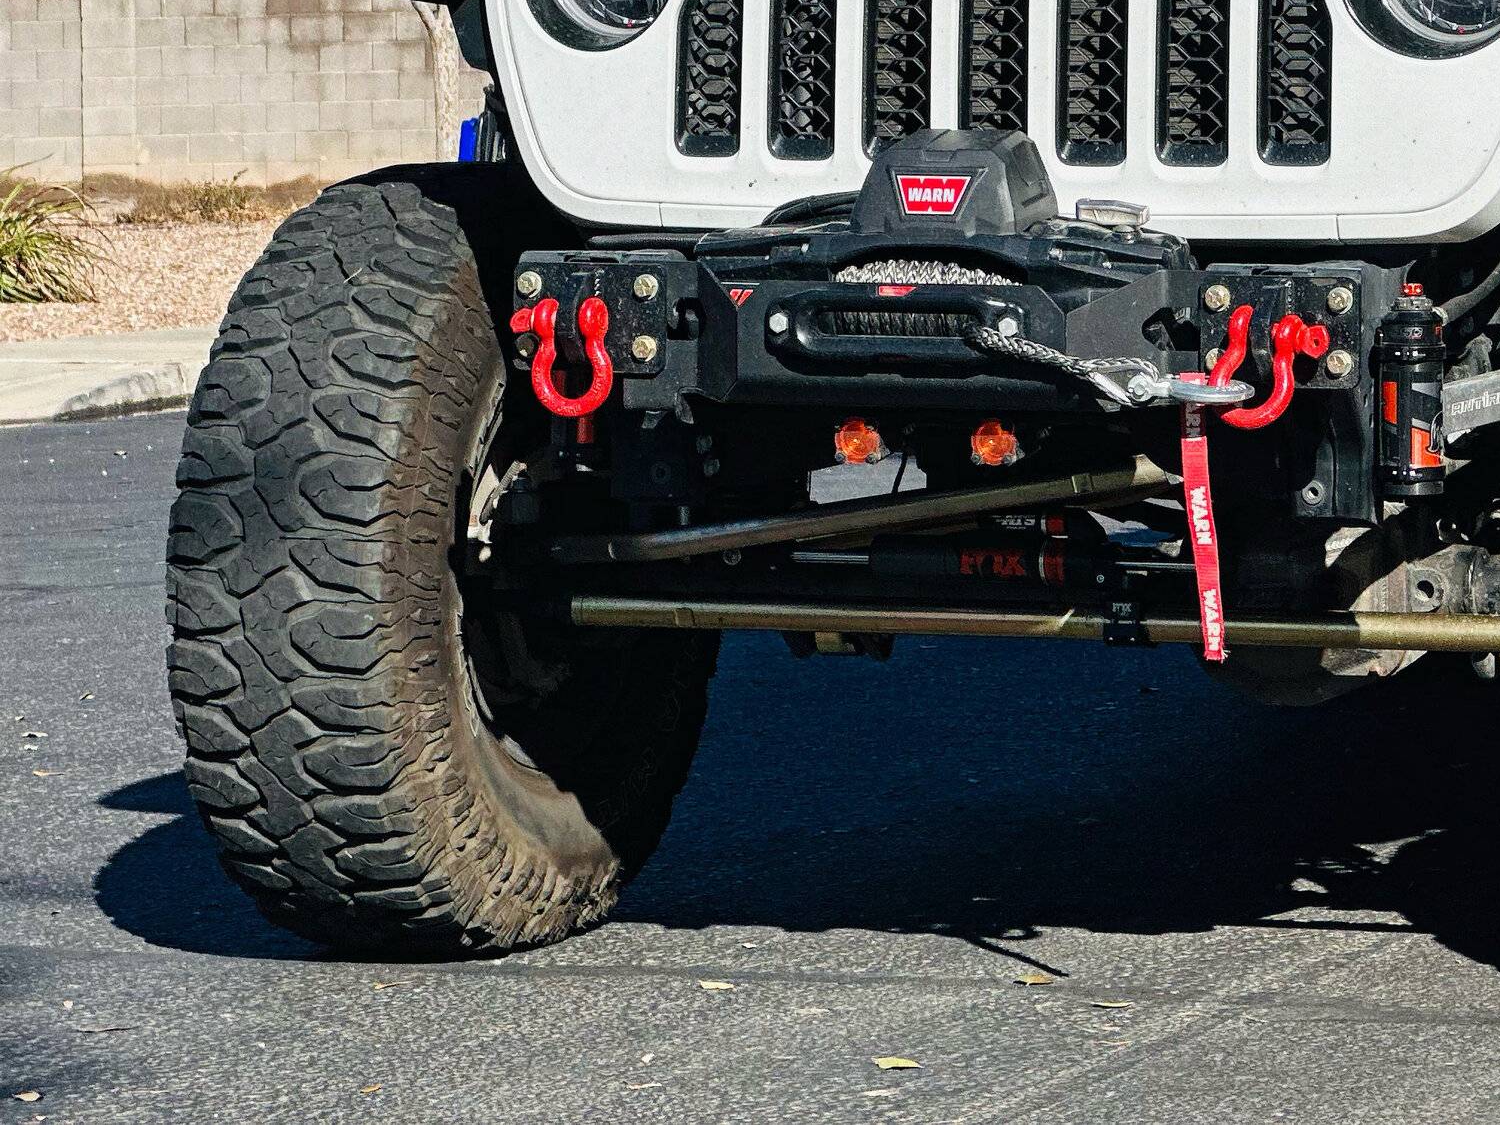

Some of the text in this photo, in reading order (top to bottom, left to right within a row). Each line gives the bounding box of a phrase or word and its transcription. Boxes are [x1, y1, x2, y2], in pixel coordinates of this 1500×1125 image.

[908, 187, 956, 203] WARN
[1190, 486, 1213, 545] WARN
[1203, 588, 1221, 651] WARN
